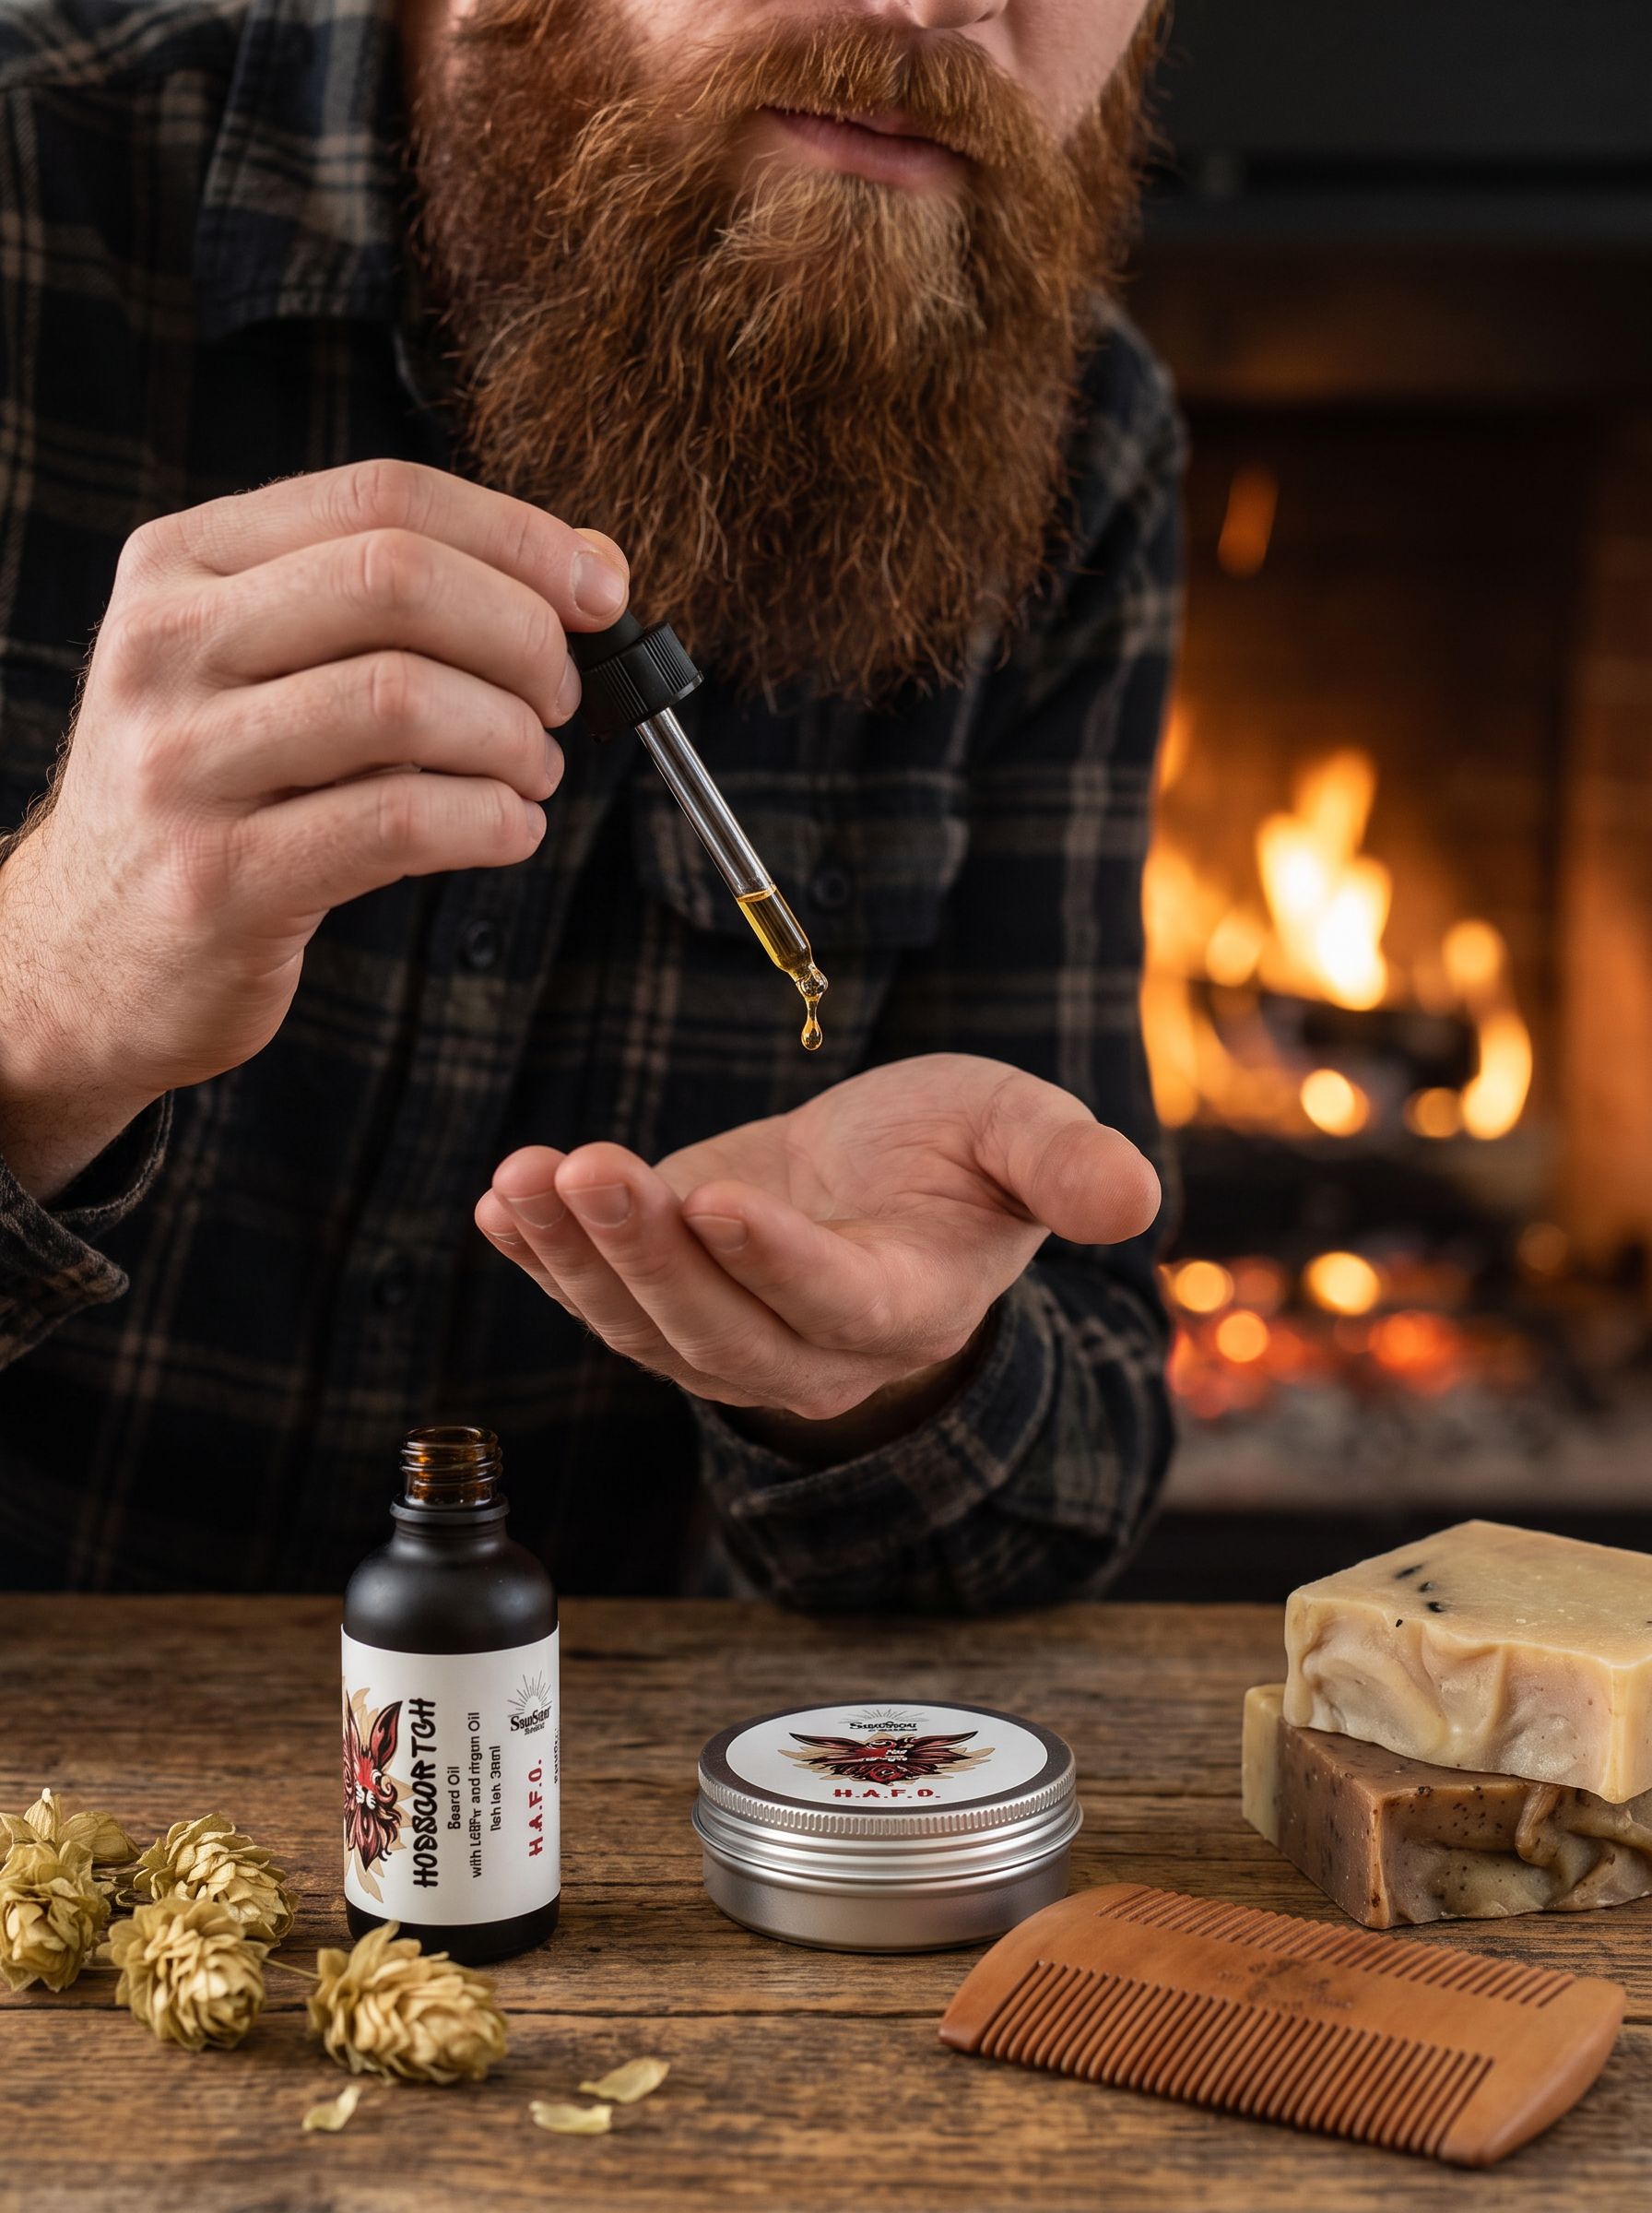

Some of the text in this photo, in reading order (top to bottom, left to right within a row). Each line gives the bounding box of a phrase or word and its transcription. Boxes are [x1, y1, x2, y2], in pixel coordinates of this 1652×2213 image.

[467, 1712, 480, 1732] Oil
[447, 1766, 461, 1829] Beard Oil
[468, 1778, 481, 1804] and
[832, 1788, 940, 1798] H.A.F.O.
[528, 1758, 543, 1857] H.A.F.O.
